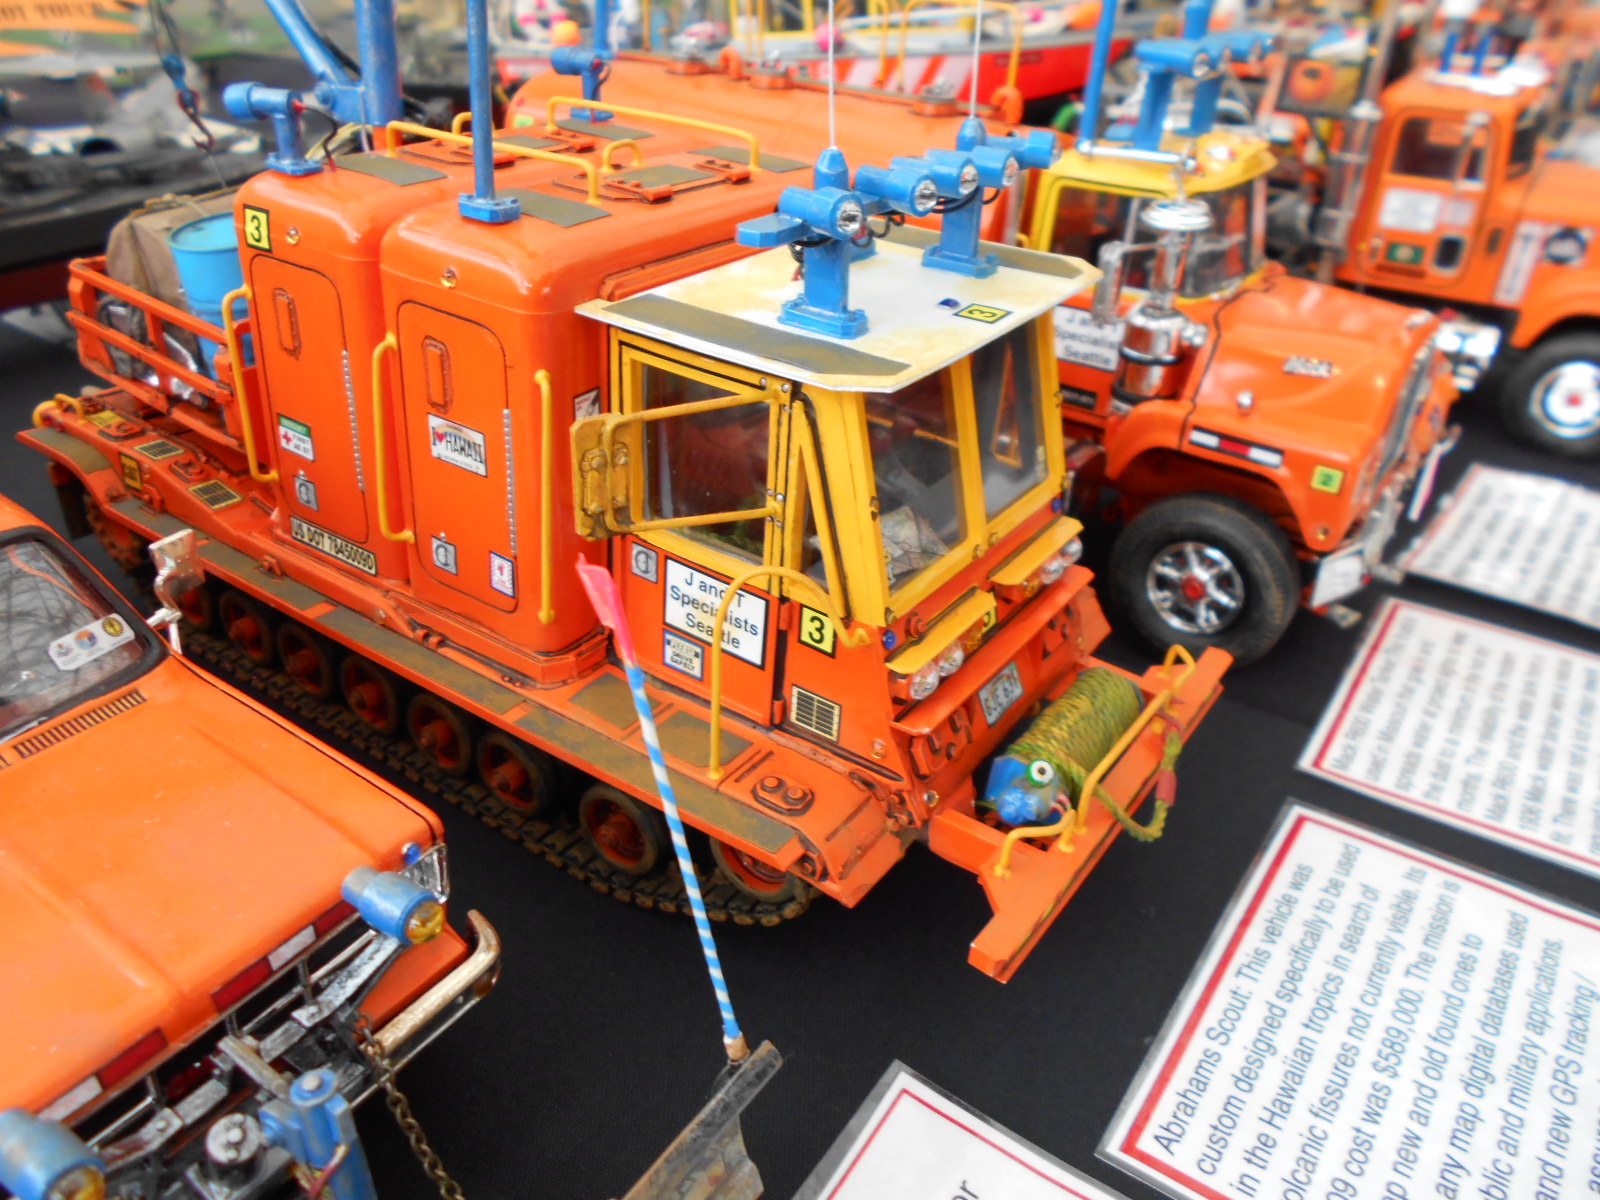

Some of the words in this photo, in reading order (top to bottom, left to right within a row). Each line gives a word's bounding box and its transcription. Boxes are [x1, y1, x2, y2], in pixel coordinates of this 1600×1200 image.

[250, 214, 262, 243] 3
[967, 308, 998, 318] 3
[445, 431, 484, 464] HAWAII
[293, 523, 305, 541] US
[307, 527, 325, 549] DOT
[685, 572, 694, 586] J
[735, 591, 745, 608] T
[686, 612, 741, 649] Seatle
[808, 616, 826, 644] 3
[1334, 842, 1362, 878] used
[1402, 866, 1428, 885] Its
[1312, 898, 1337, 915] to
[1319, 877, 1346, 898] be
[1359, 882, 1381, 902] of
[1442, 879, 1462, 894] is
[1338, 901, 1374, 955] search
[1422, 893, 1455, 951] mission
[1459, 933, 1485, 951] to
[1505, 910, 1530, 950] used
[1274, 913, 1333, 1004] specifically
[1326, 954, 1353, 973] in
[1359, 935, 1406, 1008] currently
[1403, 951, 1438, 983] The
[1450, 951, 1479, 994] ones
[1153, 1048, 1222, 1156] Abrahams
[1205, 986, 1254, 1047] Scout:
[1234, 947, 1272, 983] This
[1260, 893, 1299, 945] vehicle
[1287, 863, 1314, 892] was
[1301, 972, 1345, 1034] tropics
[1477, 949, 1520, 1037] databases
[1524, 939, 1565, 1037] applications.
[1346, 1007, 1374, 1041] not
[1371, 988, 1425, 1080] $589,000.
[1427, 990, 1466, 1047] found
[1561, 984, 1600, 1056] tracking
[1230, 1000, 1288, 1094] designed
[1420, 1045, 1449, 1082] old
[1459, 1035, 1497, 1099] digital
[1257, 1036, 1318, 1131] Hawaiian
[1308, 1041, 1361, 1124] fissures
[1505, 1036, 1548, 1111] military
[1548, 1055, 1583, 1106] GPS
[1360, 1081, 1392, 1125] was
[1408, 1079, 1439, 1128] and
[1449, 1101, 1485, 1153] map
[1196, 1095, 1247, 1176] custom
[1243, 1132, 1278, 1171] the
[1343, 1126, 1377, 1178] cost
[1392, 1127, 1424, 1180] new
[1496, 1107, 1525, 1158] and
[1545, 1108, 1574, 1160] new
[1229, 1173, 1261, 1198] in
[1276, 1125, 1329, 1200] olcanic
[1478, 1158, 1515, 1200] blic
